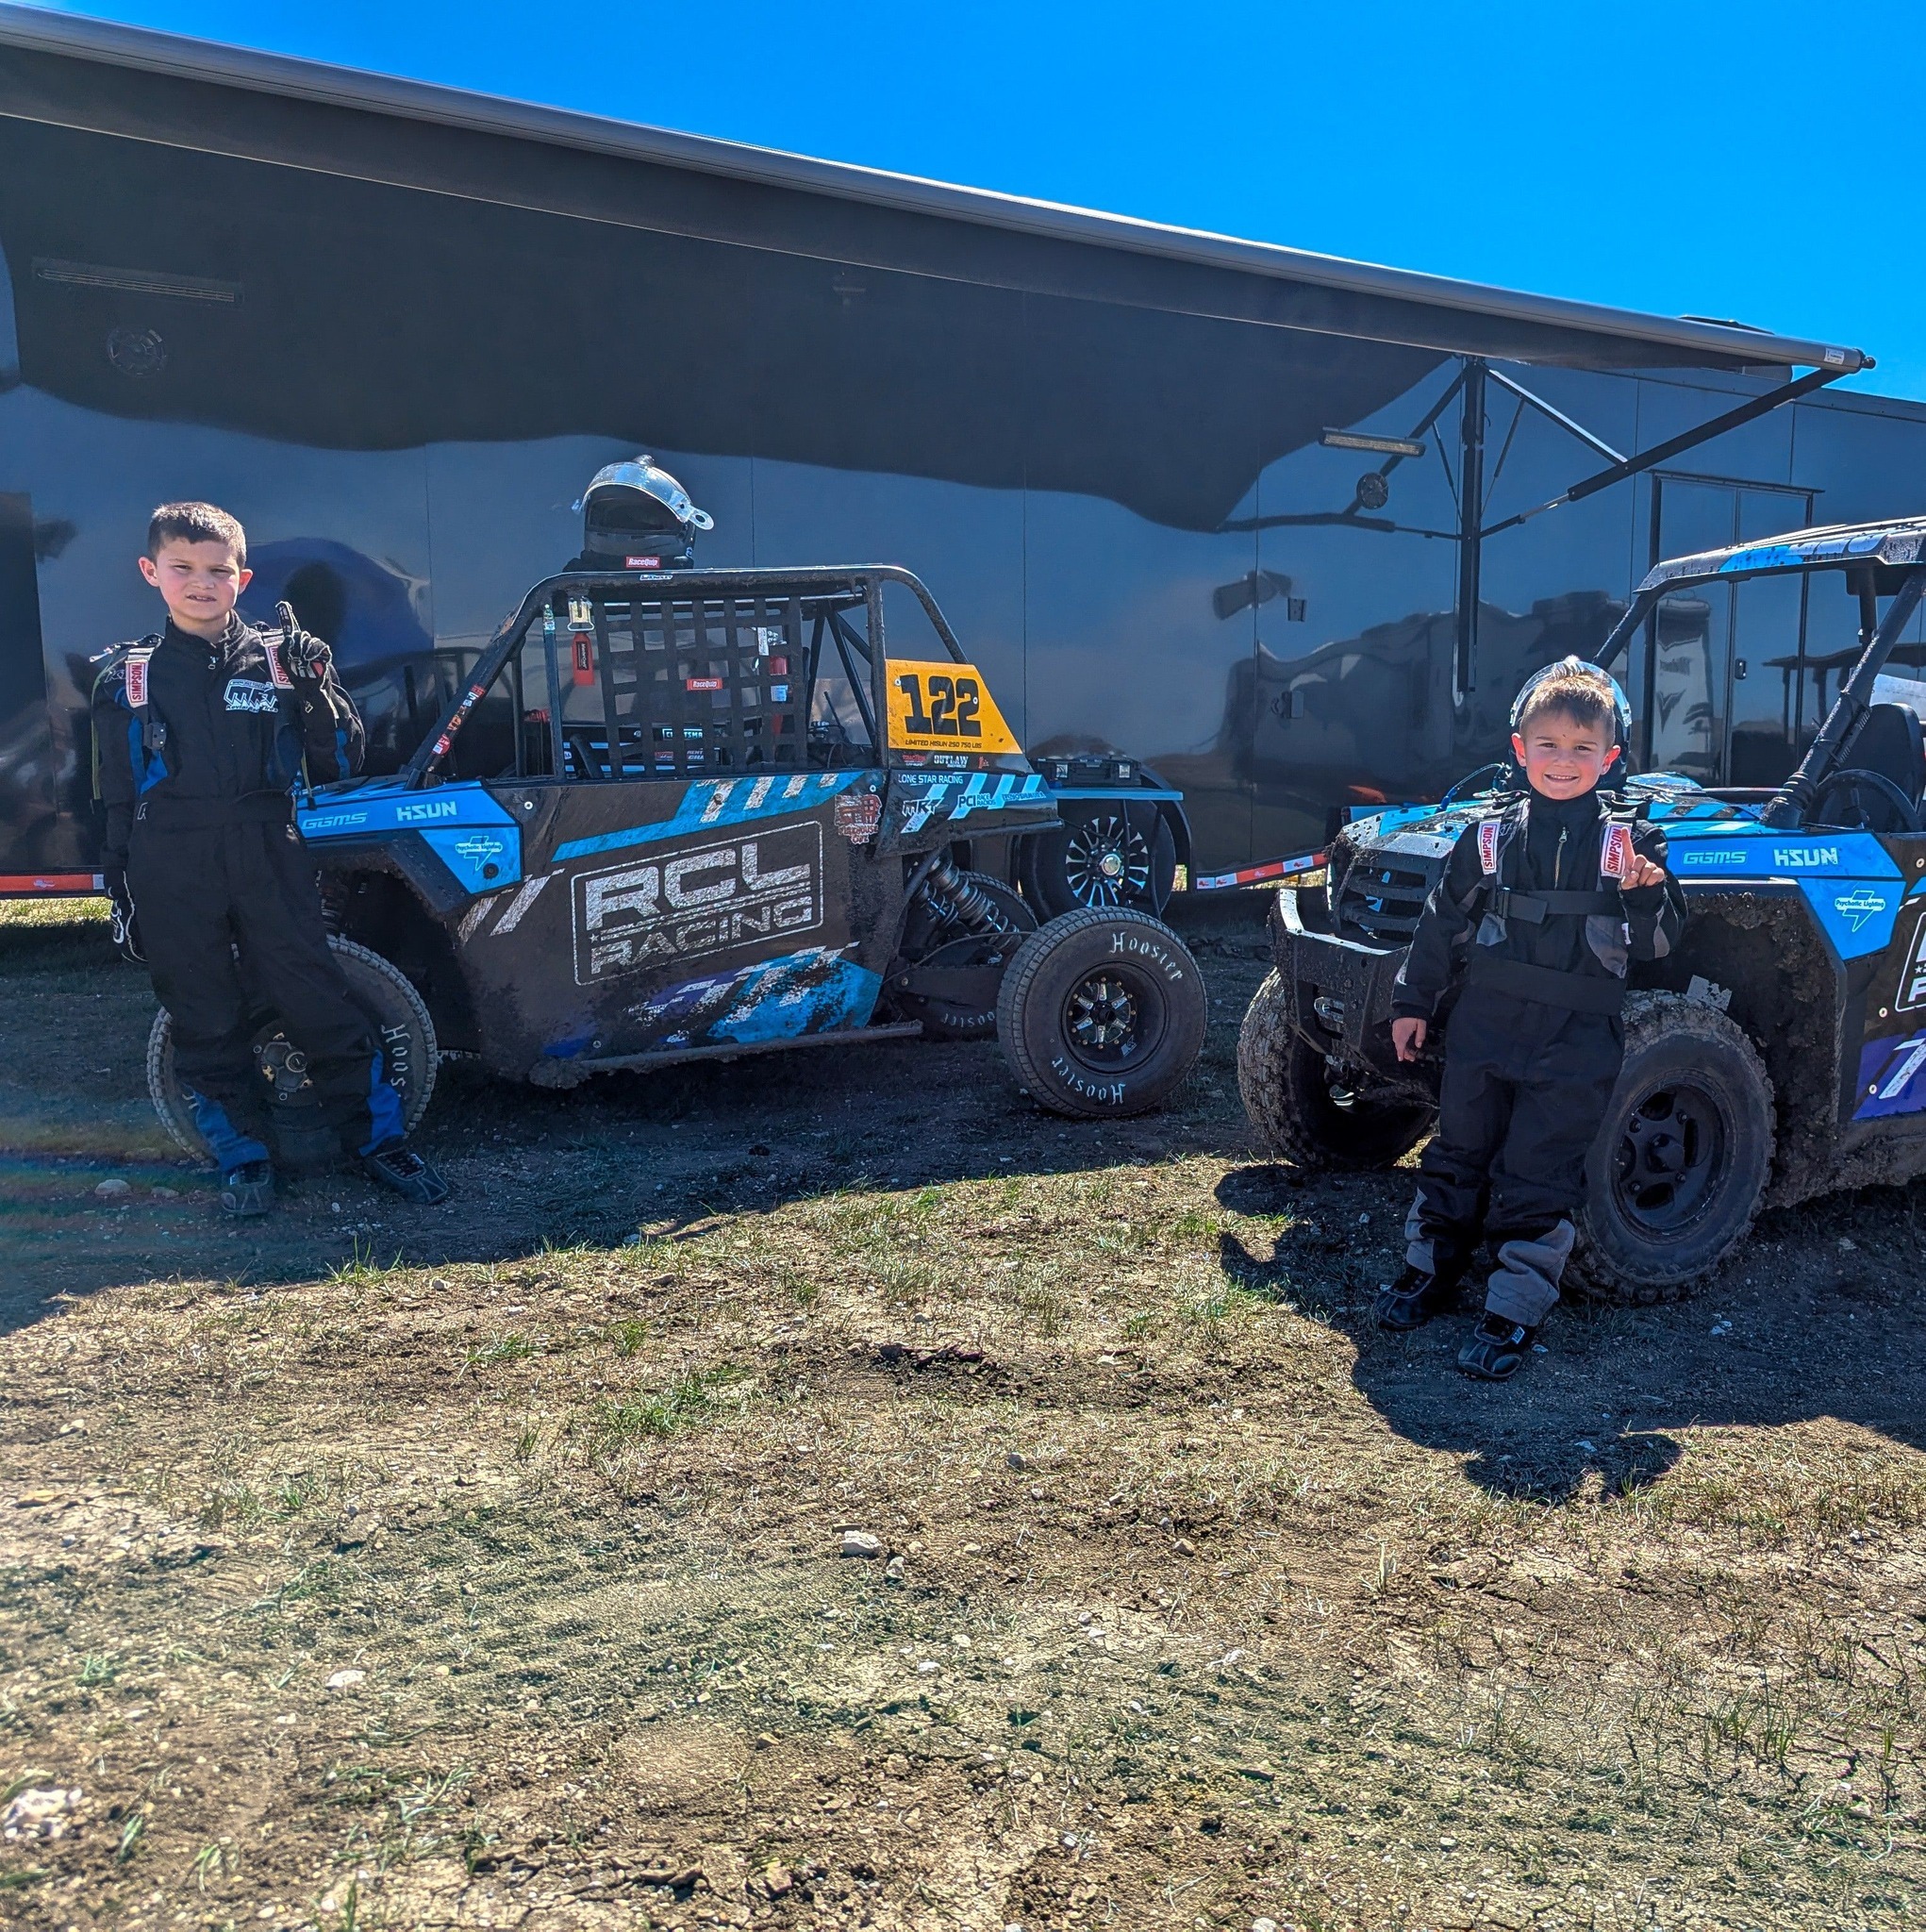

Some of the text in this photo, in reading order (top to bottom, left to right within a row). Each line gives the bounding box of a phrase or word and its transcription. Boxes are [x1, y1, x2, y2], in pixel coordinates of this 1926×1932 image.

[130, 662, 144, 701] SIMPSON
[901, 674, 983, 738] 122
[898, 774, 964, 784] LONE STAR RACING
[934, 755, 969, 766] OUTLAW
[958, 794, 976, 808] PCI
[1483, 826, 1494, 867] SIMPSON
[1607, 828, 1623, 872] SIMPSON
[585, 842, 811, 930] RCL
[590, 896, 813, 974] RACING
[1109, 931, 1184, 981] Hoosier
[941, 1011, 995, 1027] oosier
[1051, 1057, 1126, 1106] Hoosier
